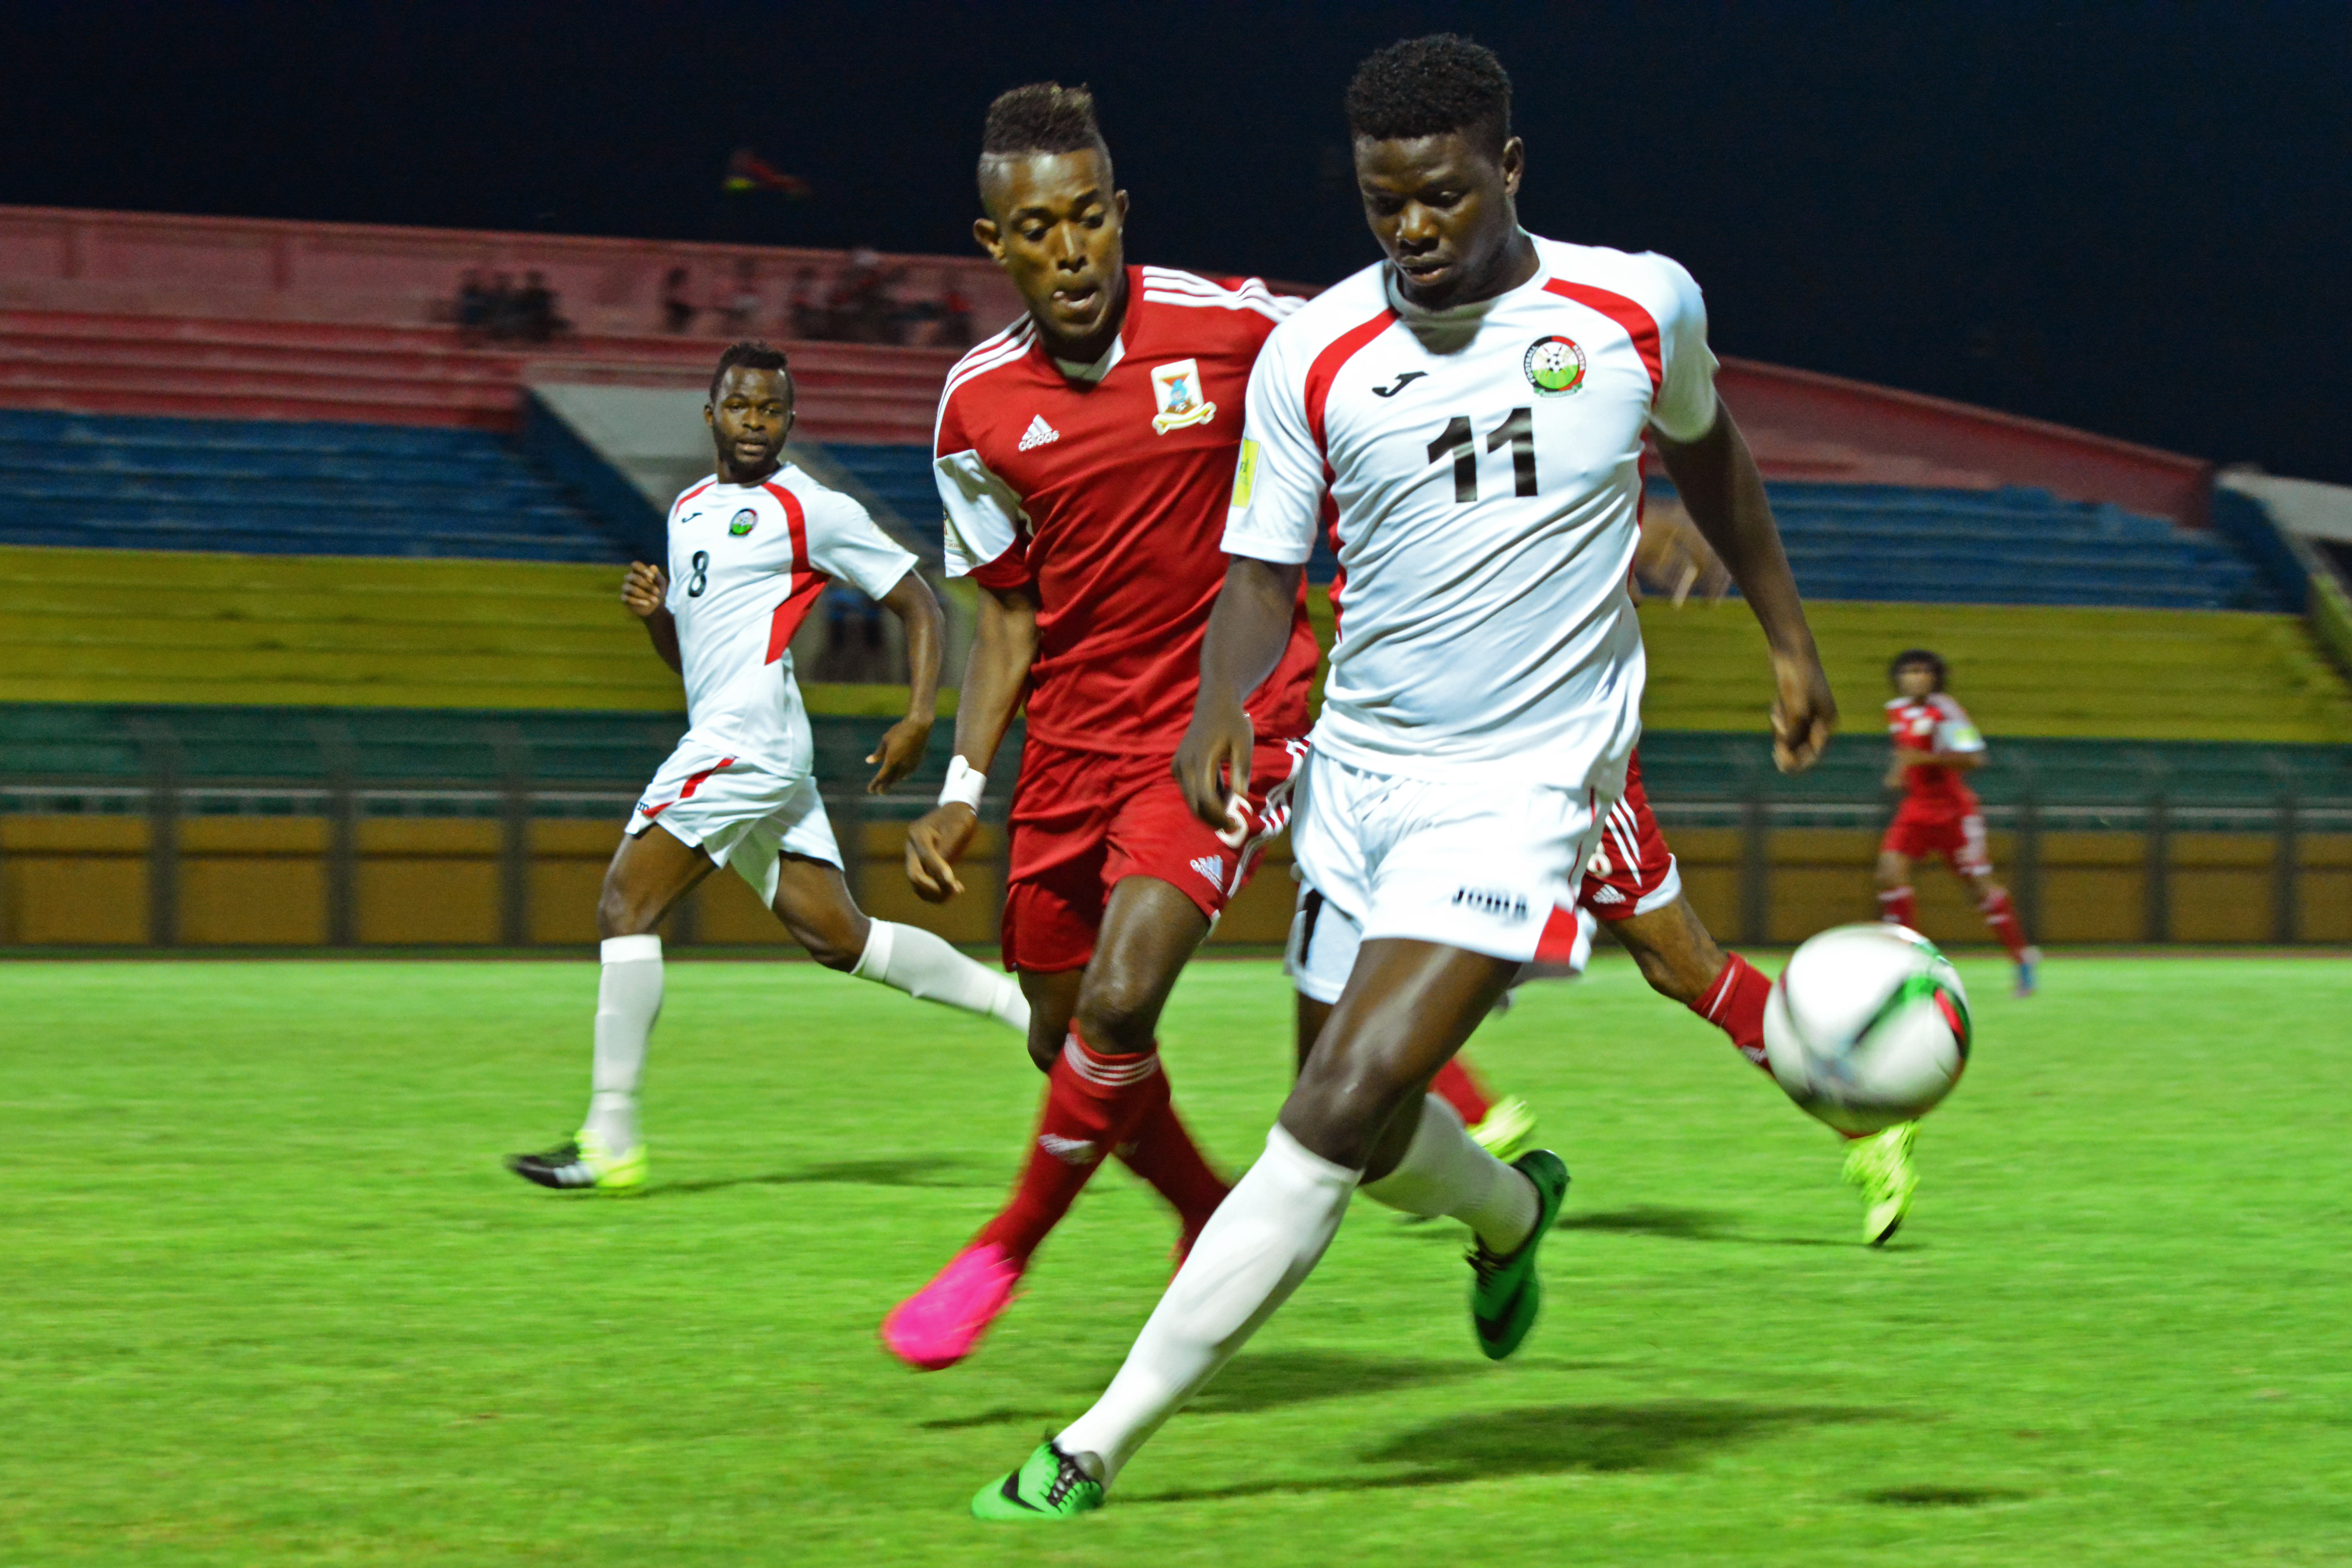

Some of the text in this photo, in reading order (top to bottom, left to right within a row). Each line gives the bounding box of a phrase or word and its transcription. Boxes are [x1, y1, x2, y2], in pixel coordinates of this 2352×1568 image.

[1018, 430, 1060, 452] adidas
[1426, 407, 1538, 503] 11
[688, 550, 710, 597] 8
[1215, 792, 1253, 849] 5
